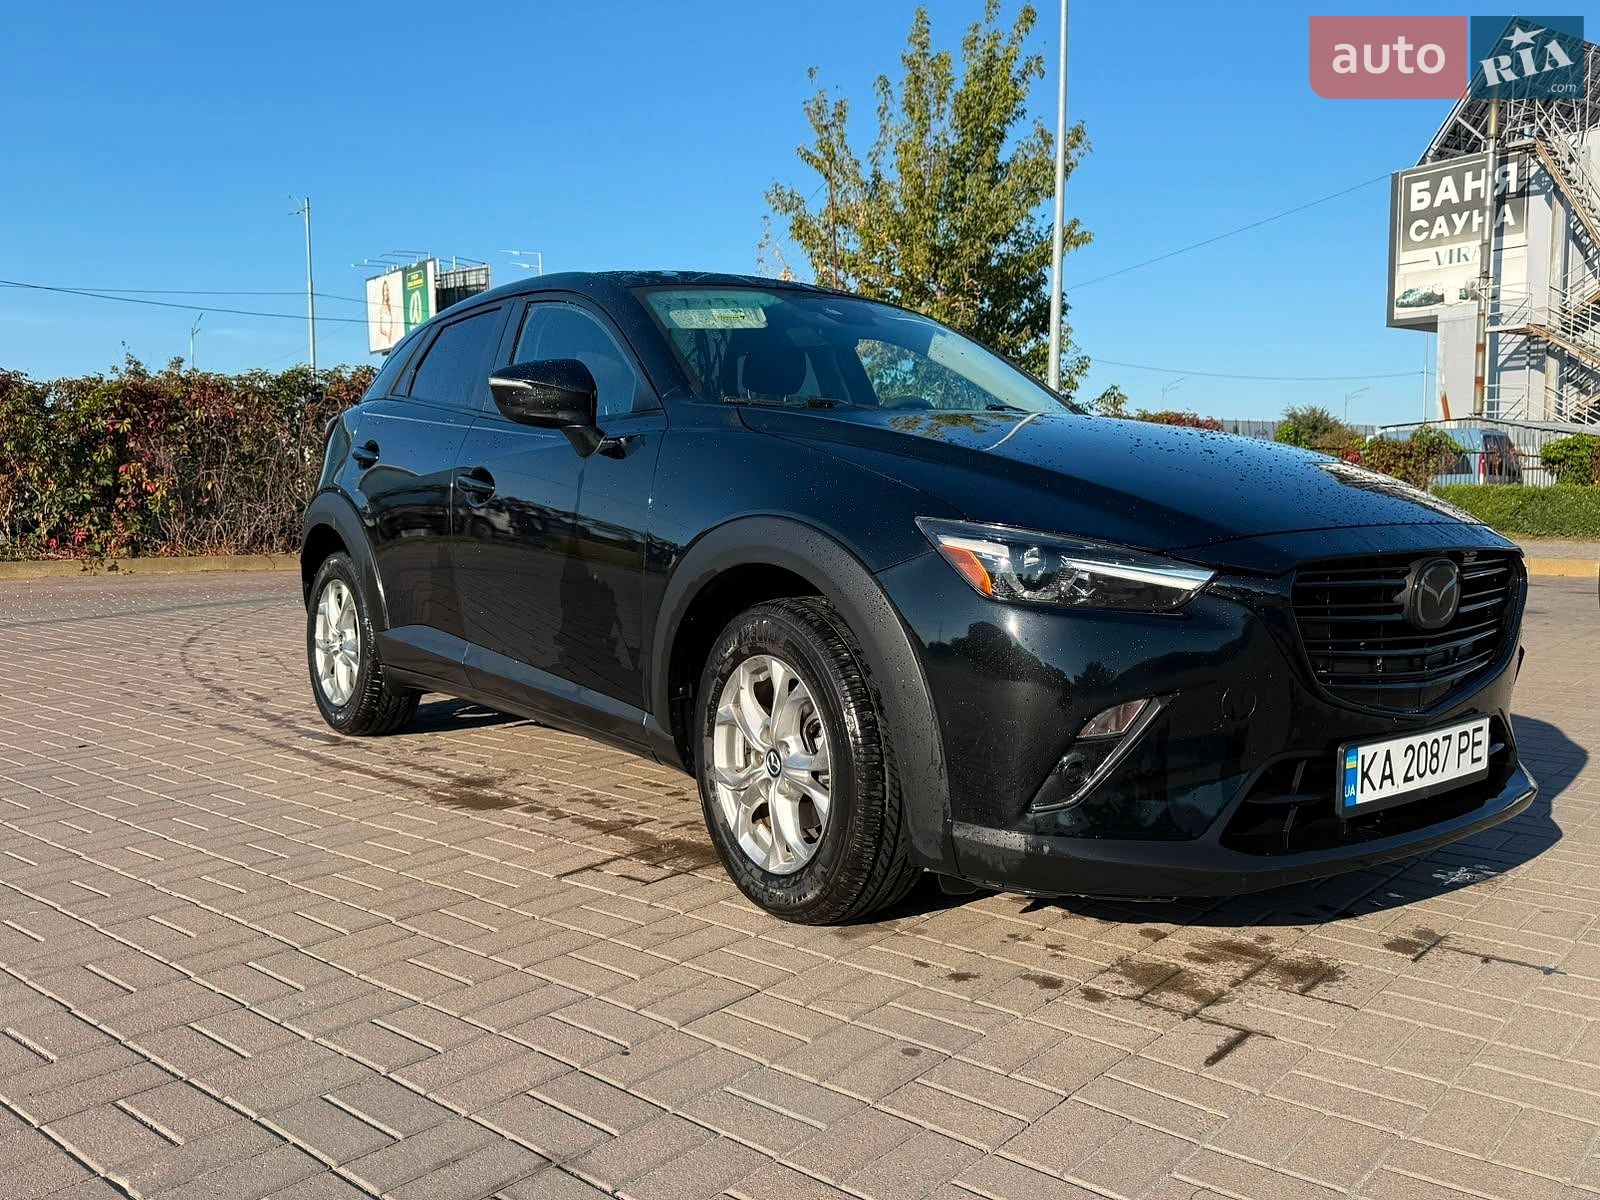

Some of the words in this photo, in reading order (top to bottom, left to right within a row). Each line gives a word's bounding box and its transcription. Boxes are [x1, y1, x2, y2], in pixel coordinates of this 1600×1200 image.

[1410, 161, 1518, 212] БАНЯ
[1360, 749, 1395, 794] KA
[1403, 734, 1452, 784] 2087
[1457, 726, 1483, 769] PE
[1344, 785, 1356, 797] UA
